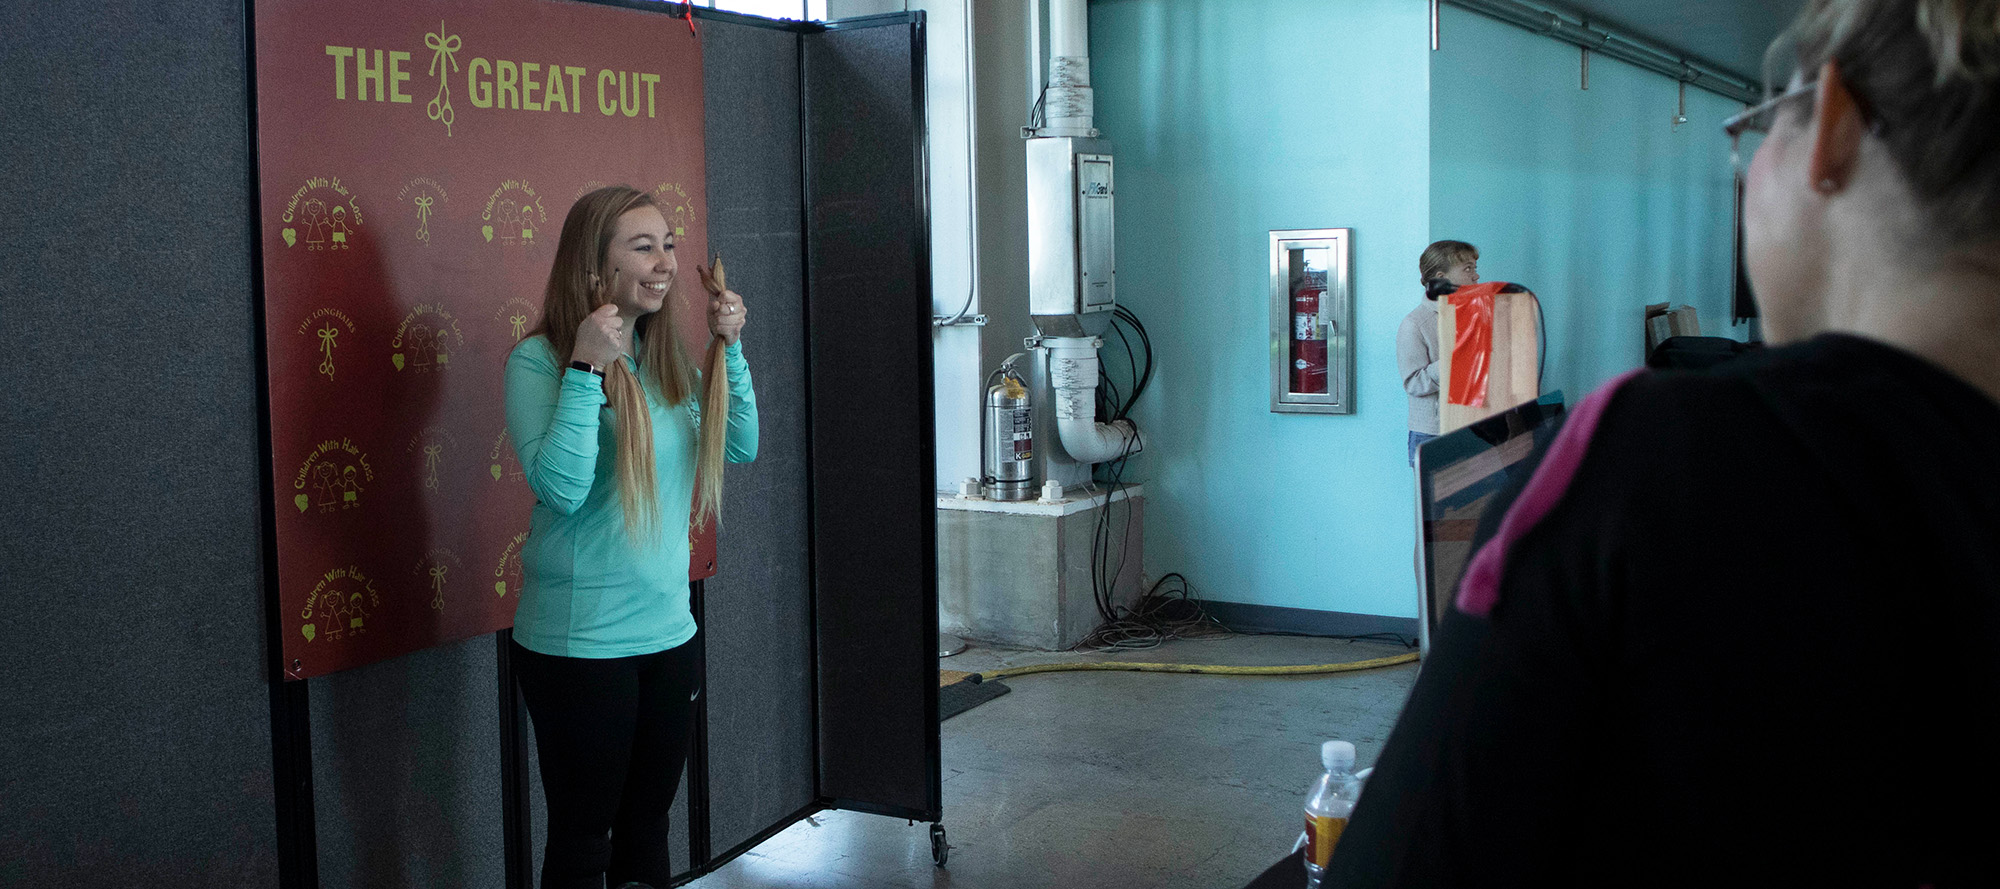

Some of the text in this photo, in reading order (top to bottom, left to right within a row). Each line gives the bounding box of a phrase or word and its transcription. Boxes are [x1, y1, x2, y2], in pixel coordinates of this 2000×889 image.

[325, 45, 661, 118] THE GREAT CUT
[282, 176, 363, 225] Children With Hair Loss
[481, 179, 547, 223] Children With Hair Loss
[686, 197, 697, 222] Loss
[298, 308, 356, 335] THE LONGHAIRS
[392, 302, 464, 348] Children With Hair Loss
[294, 436, 374, 489] Children With Hair Loss
[495, 541, 516, 577] Children
[301, 564, 380, 620] Children With Hair Loss
